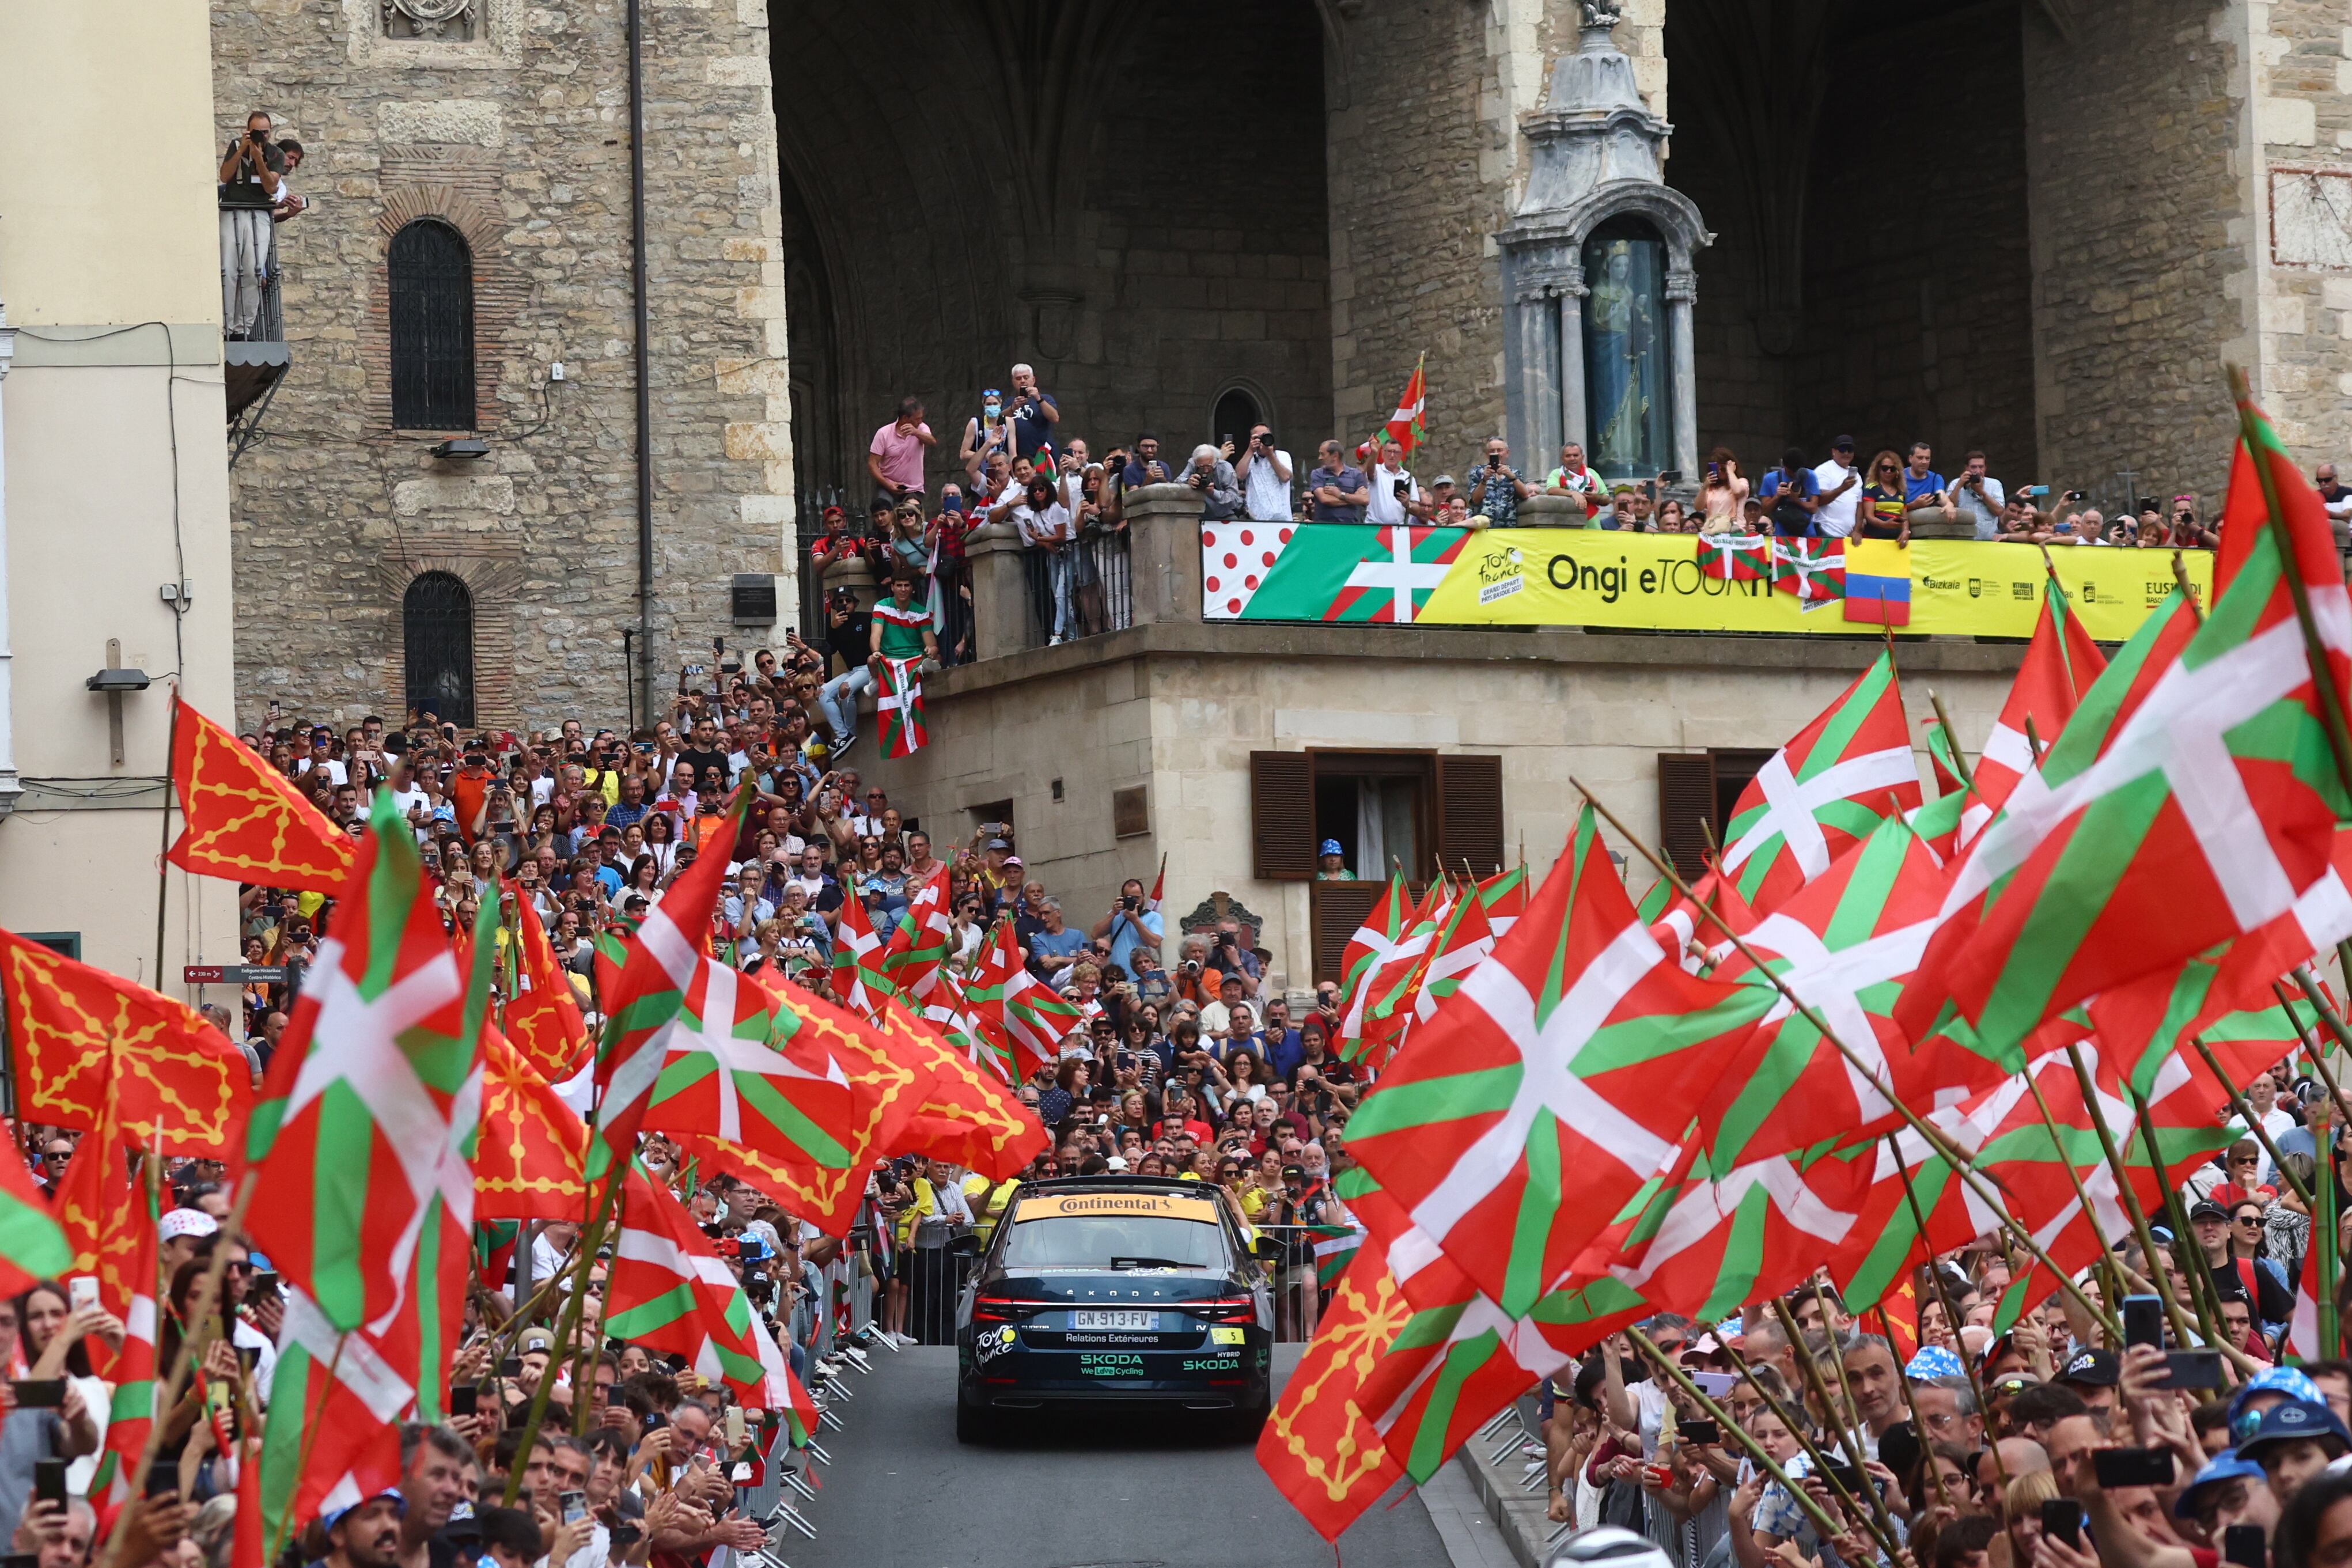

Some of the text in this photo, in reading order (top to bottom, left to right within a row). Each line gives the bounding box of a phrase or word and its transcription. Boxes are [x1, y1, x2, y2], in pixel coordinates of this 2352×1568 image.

[1548, 554, 1627, 603] Ongi
[1930, 580, 1960, 589] Bizkaia
[1481, 584, 1522, 603] PAYS BASQUE 2023
[1483, 585, 1501, 596] GRAND
[1059, 1197, 1157, 1213] Continental
[1078, 1312, 1147, 1325] GN-913-FV
[1066, 1334, 1159, 1343] Relations Extérieures
[1230, 1332, 1236, 1341] 5
[1115, 1368, 1143, 1376] Cycling
